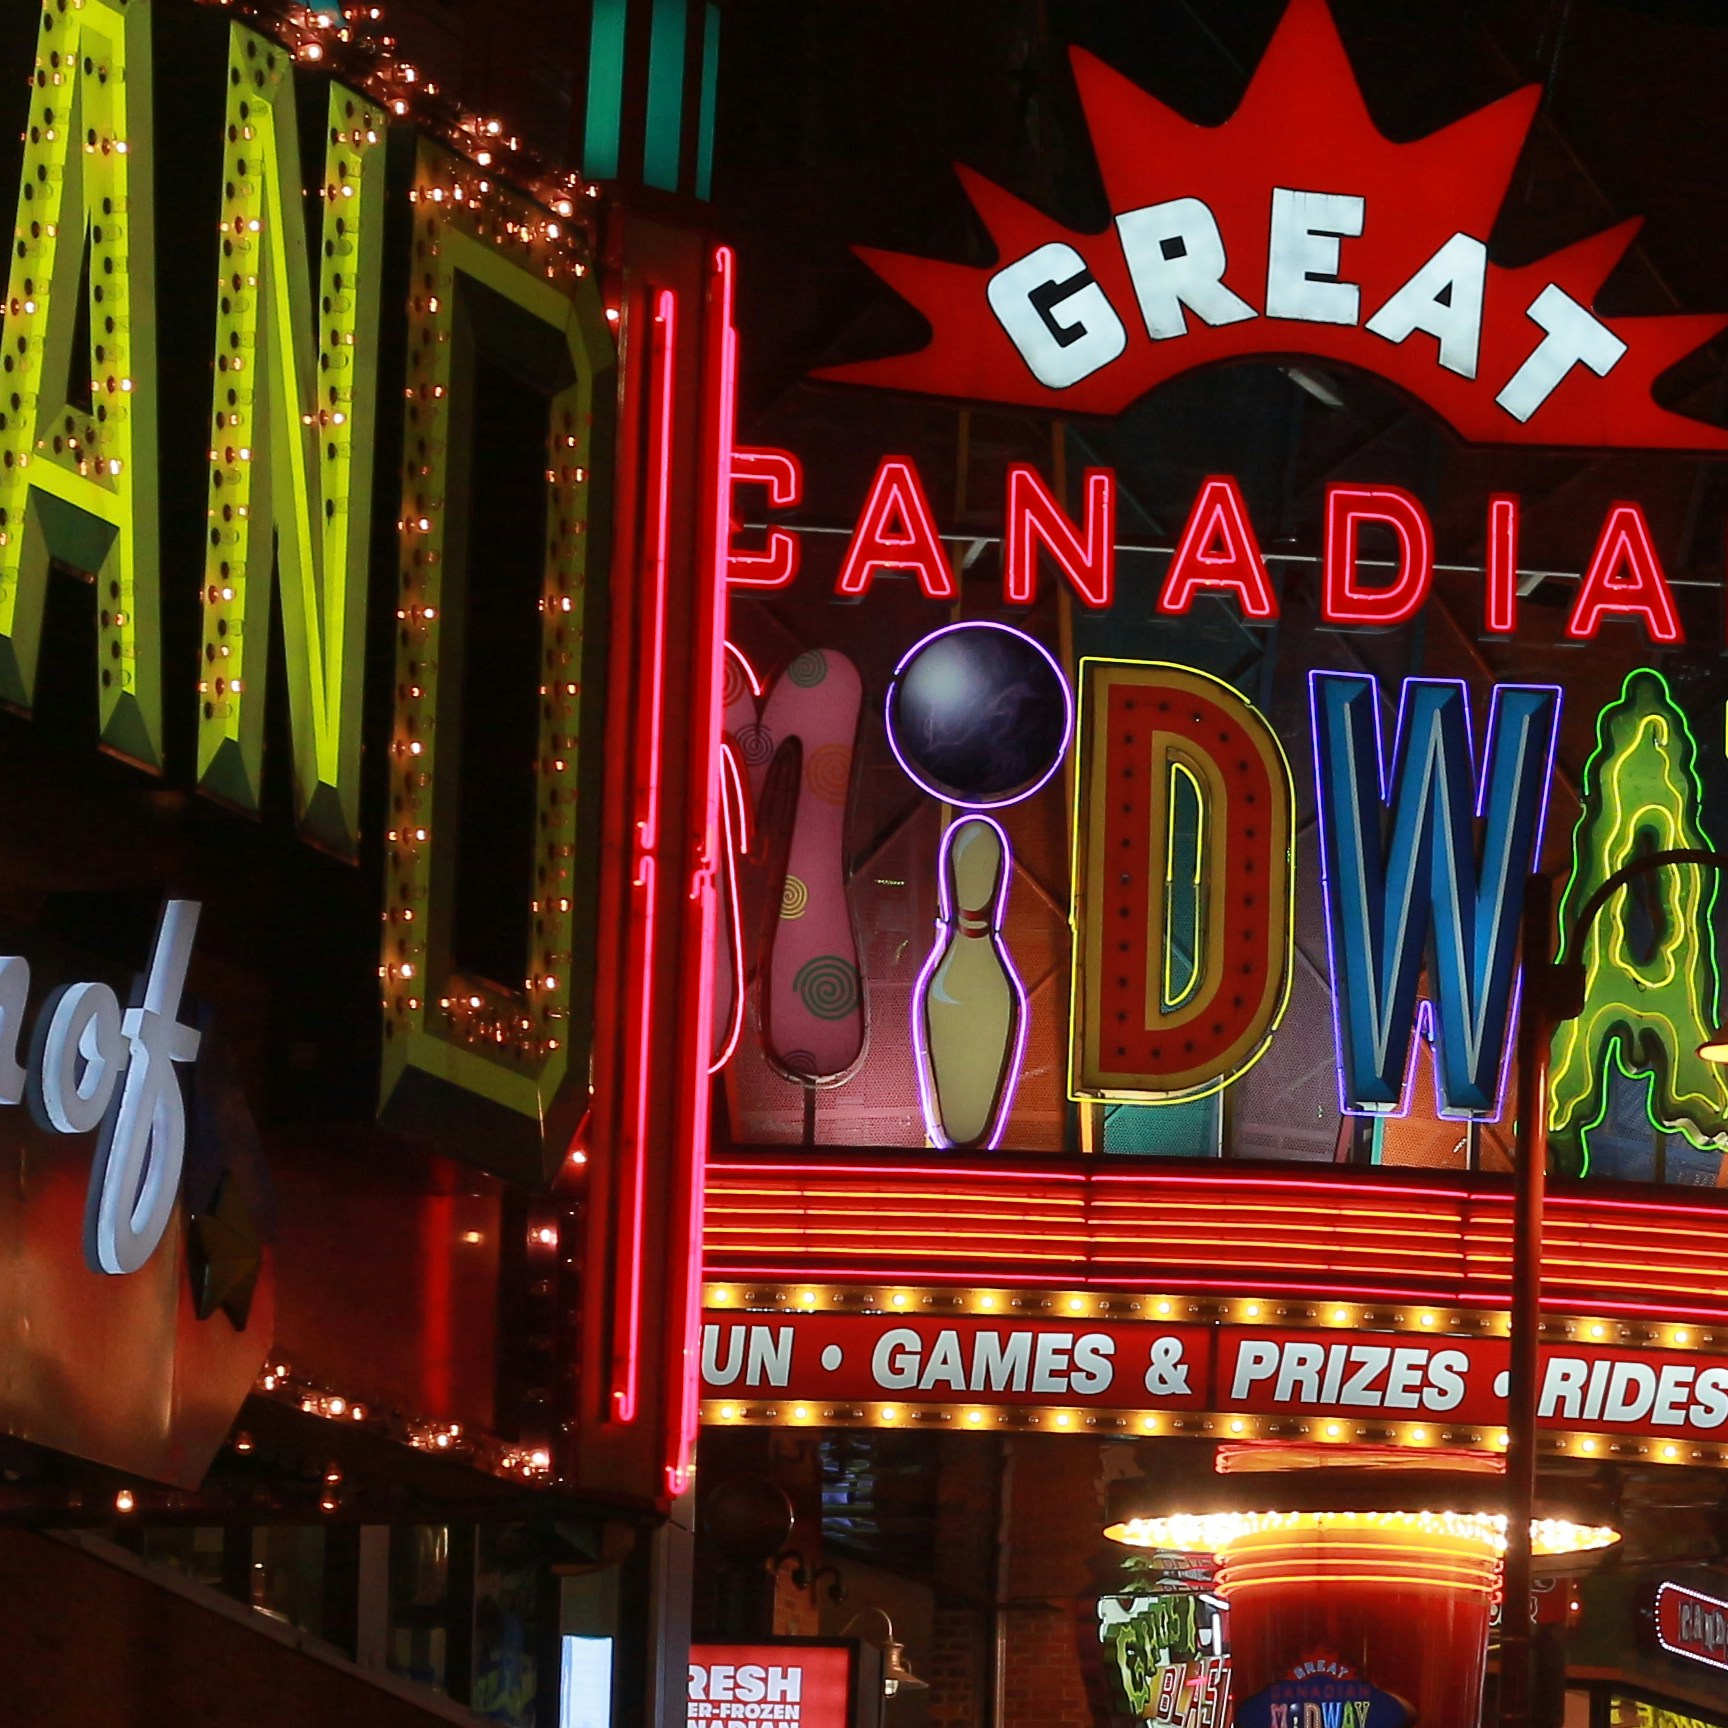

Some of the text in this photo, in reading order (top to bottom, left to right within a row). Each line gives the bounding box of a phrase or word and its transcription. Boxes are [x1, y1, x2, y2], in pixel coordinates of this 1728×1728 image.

[986, 186, 1629, 424] GREAT
[871, 1329, 1115, 1396] GAMES
[1144, 1335, 1194, 1396] &
[1230, 1340, 1470, 1411] PRIZES
[1292, 1659, 1349, 1680] GREAT
